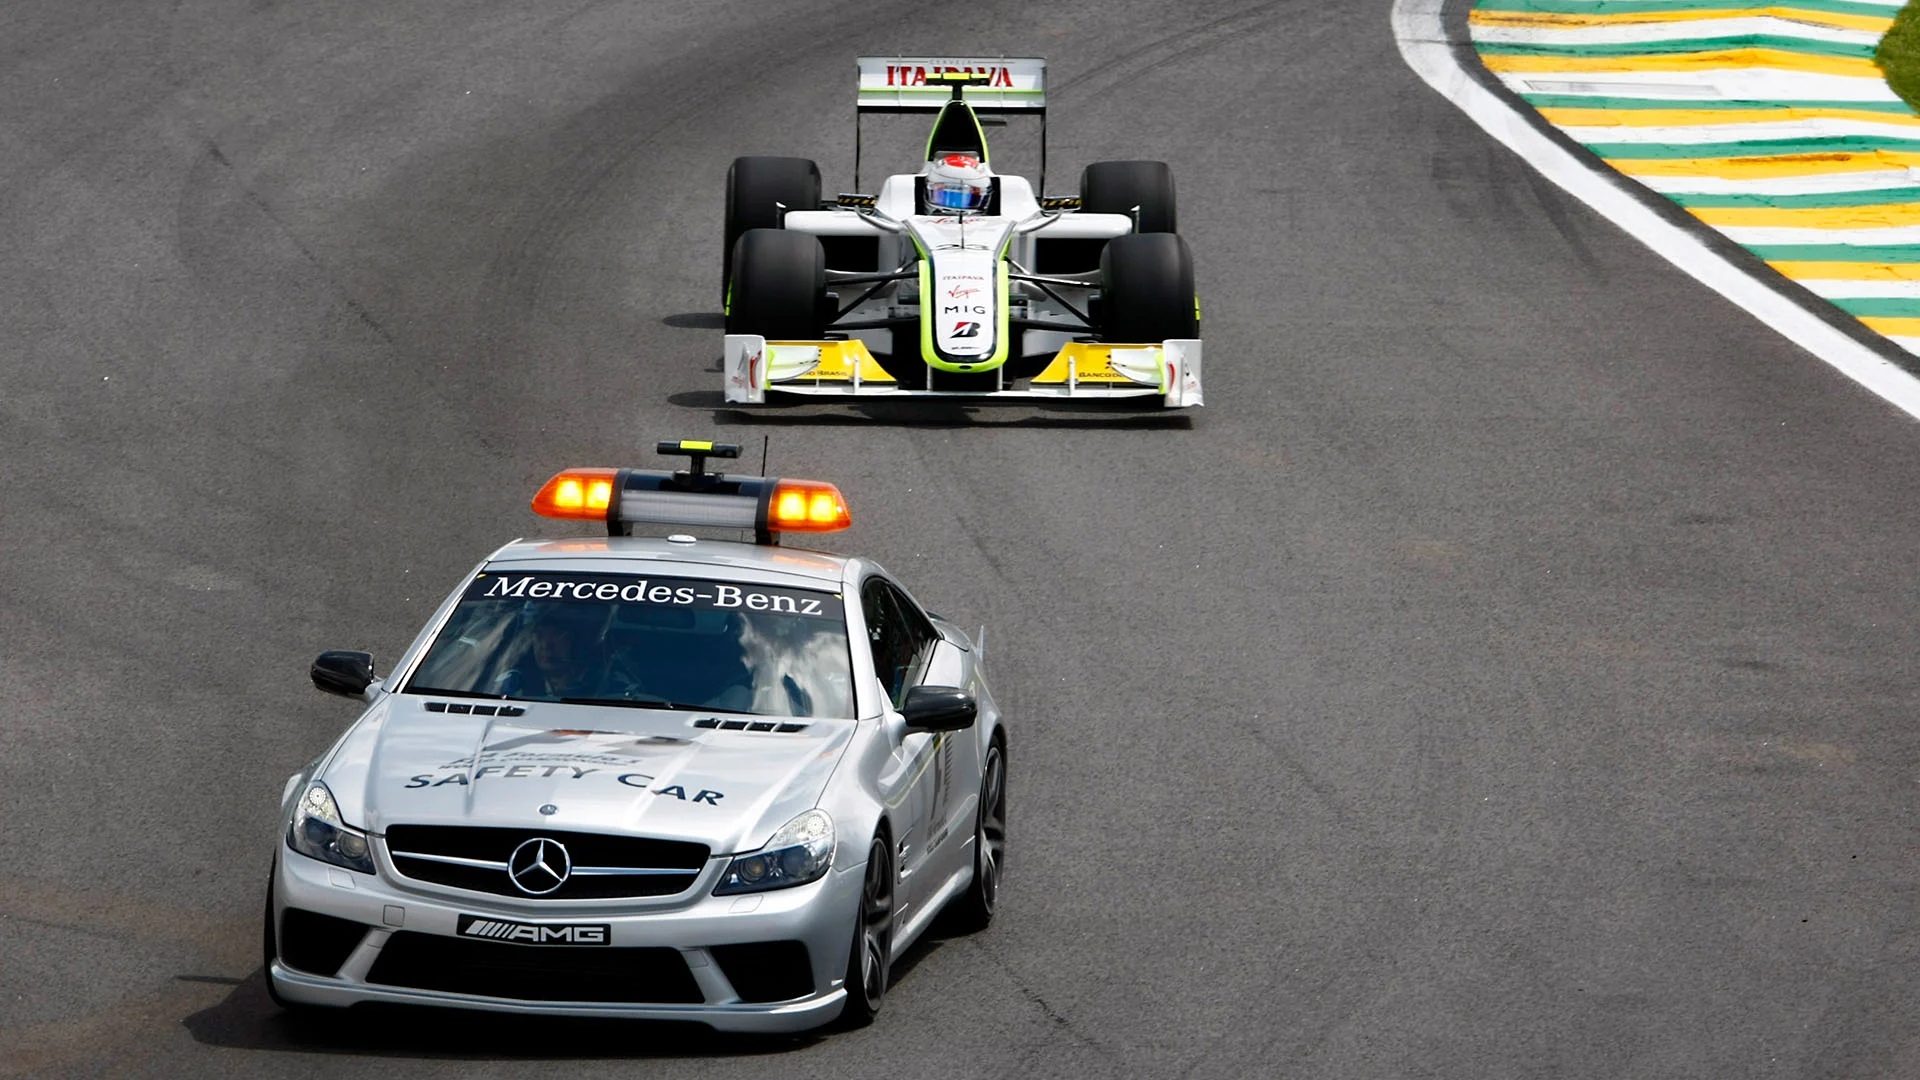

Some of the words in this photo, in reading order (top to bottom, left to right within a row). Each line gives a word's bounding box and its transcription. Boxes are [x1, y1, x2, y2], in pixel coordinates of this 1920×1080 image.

[887, 66, 1013, 87] ITAVA
[944, 305, 986, 315] MIG
[484, 576, 823, 616] Mercedes-Benz
[404, 764, 602, 788] SAFETY
[617, 773, 724, 806] CAR
